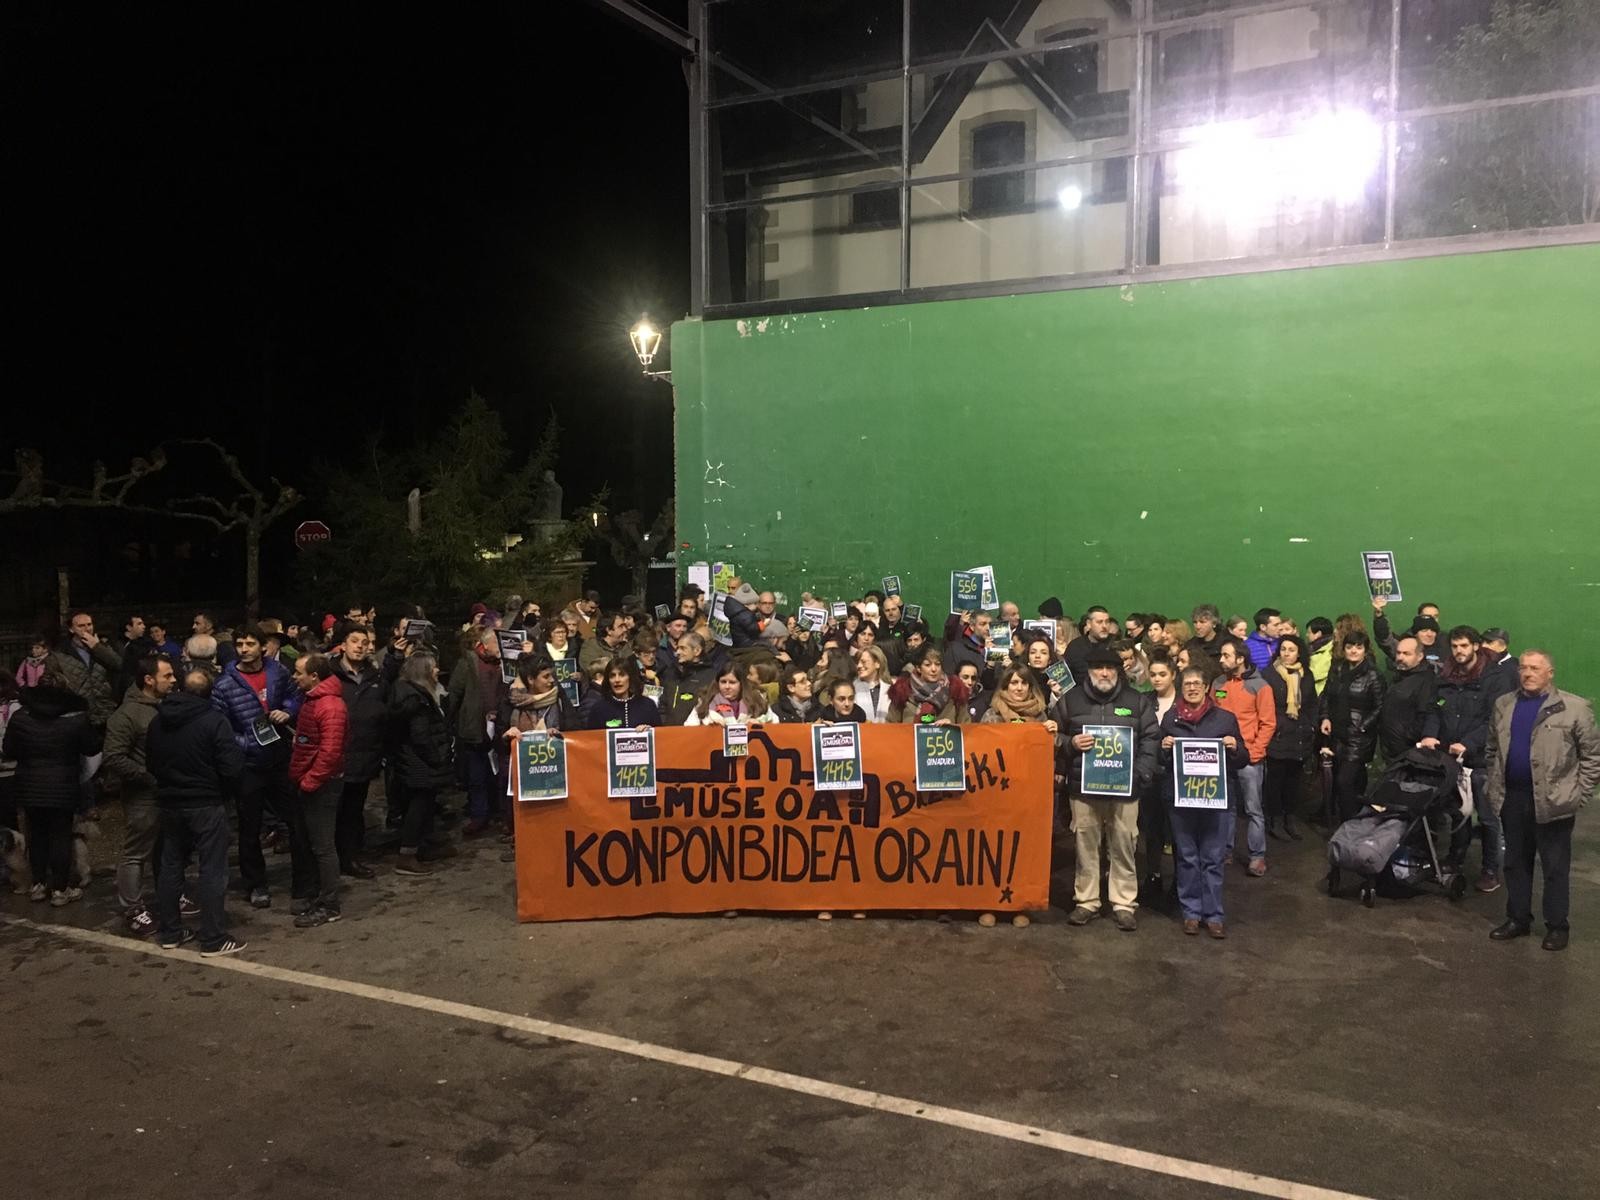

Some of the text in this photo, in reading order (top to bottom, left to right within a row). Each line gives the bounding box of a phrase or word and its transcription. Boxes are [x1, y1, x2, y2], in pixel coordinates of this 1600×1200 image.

[299, 532, 328, 542] STOP
[958, 577, 977, 593] 556
[528, 738, 556, 765] 556
[926, 730, 954, 756] 556
[1094, 733, 1122, 758] 556
[616, 766, 648, 787] 1415
[823, 760, 853, 782] 1415
[1184, 776, 1218, 799] 1415
[566, 824, 1021, 904] KONPONBIDEA ORAIN!
